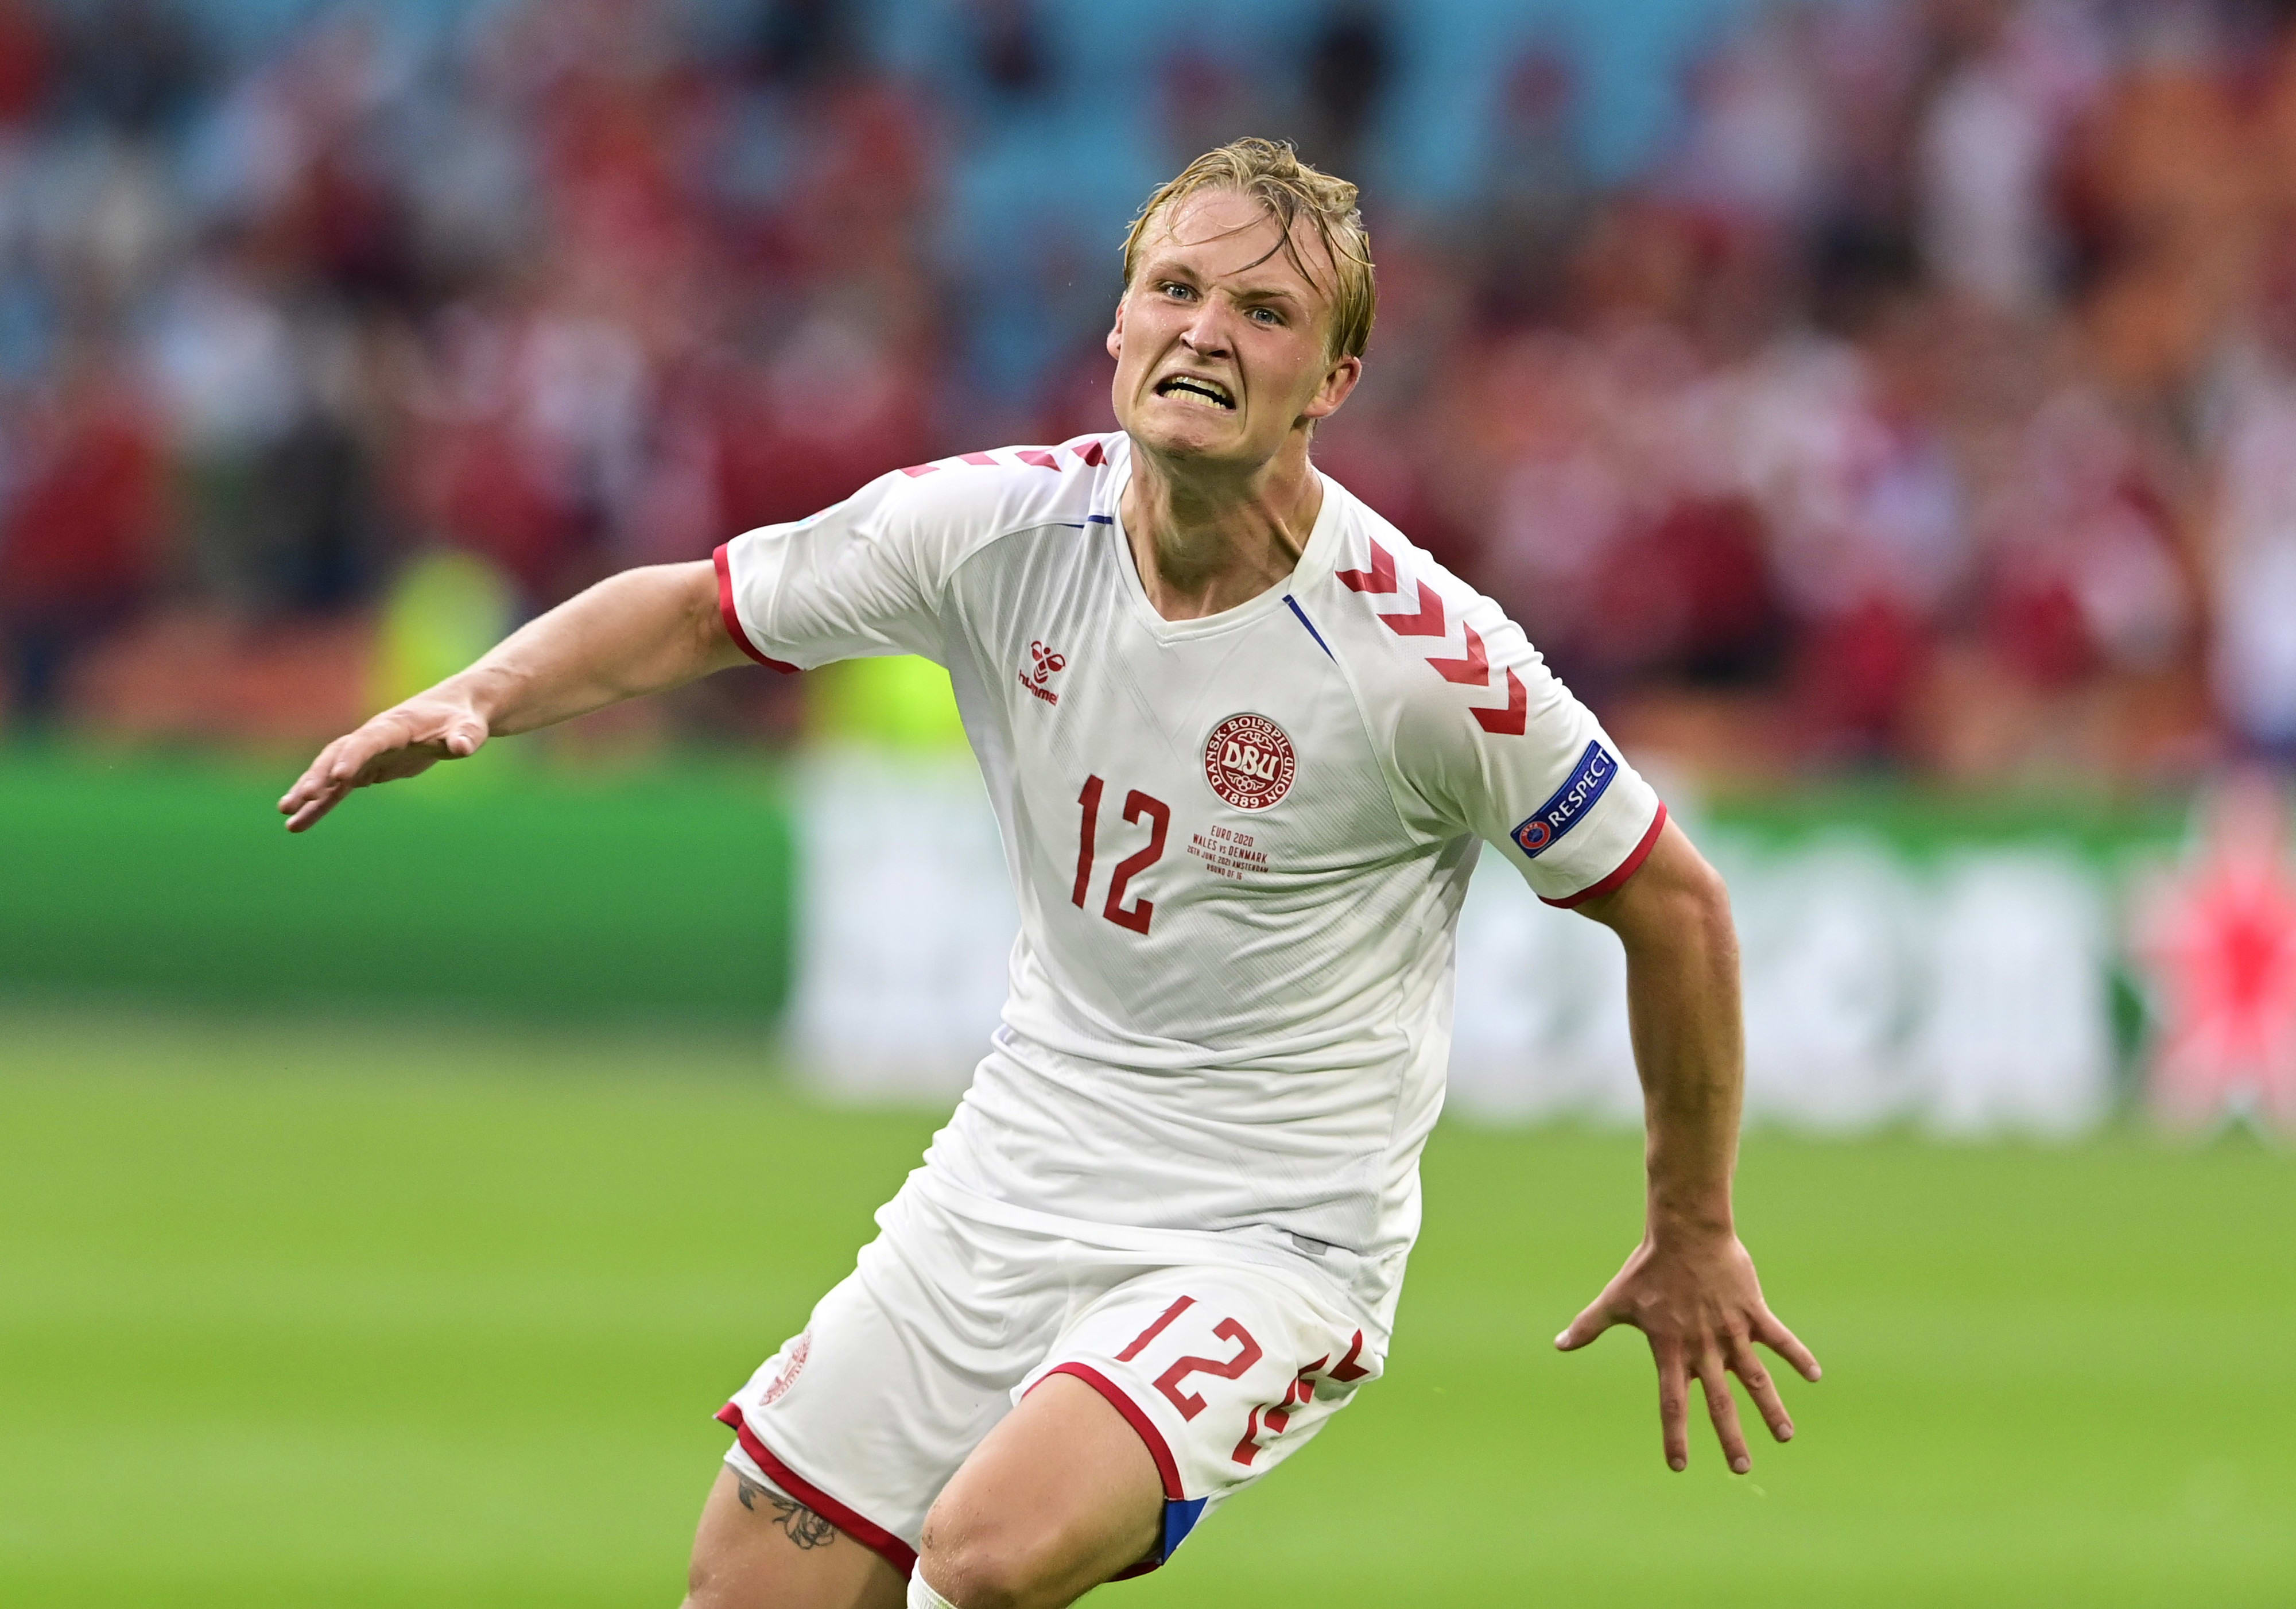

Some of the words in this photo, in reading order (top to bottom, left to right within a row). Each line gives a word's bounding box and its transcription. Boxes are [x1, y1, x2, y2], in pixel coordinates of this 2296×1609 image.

[1207, 730, 1227, 786] DANSK
[1221, 740, 1279, 781] DBU
[1222, 788, 1259, 808] 1889
[1548, 748, 1609, 827] RESPECT
[1193, 833, 1217, 851] WALES
[1228, 846, 1267, 864] DENMARK
[1211, 825, 1232, 841] EURO
[1233, 832, 1254, 847] 2020
[1072, 773, 1170, 936] 12
[1187, 845, 1200, 856] 26TH
[1201, 851, 1216, 862] JUNE
[1218, 856, 1231, 866] 2021
[1232, 860, 1269, 873] AMSTERDAM
[1207, 863, 1225, 876] ROUND
[1227, 869, 1235, 878] OF
[1112, 1294, 1263, 1422] 12
